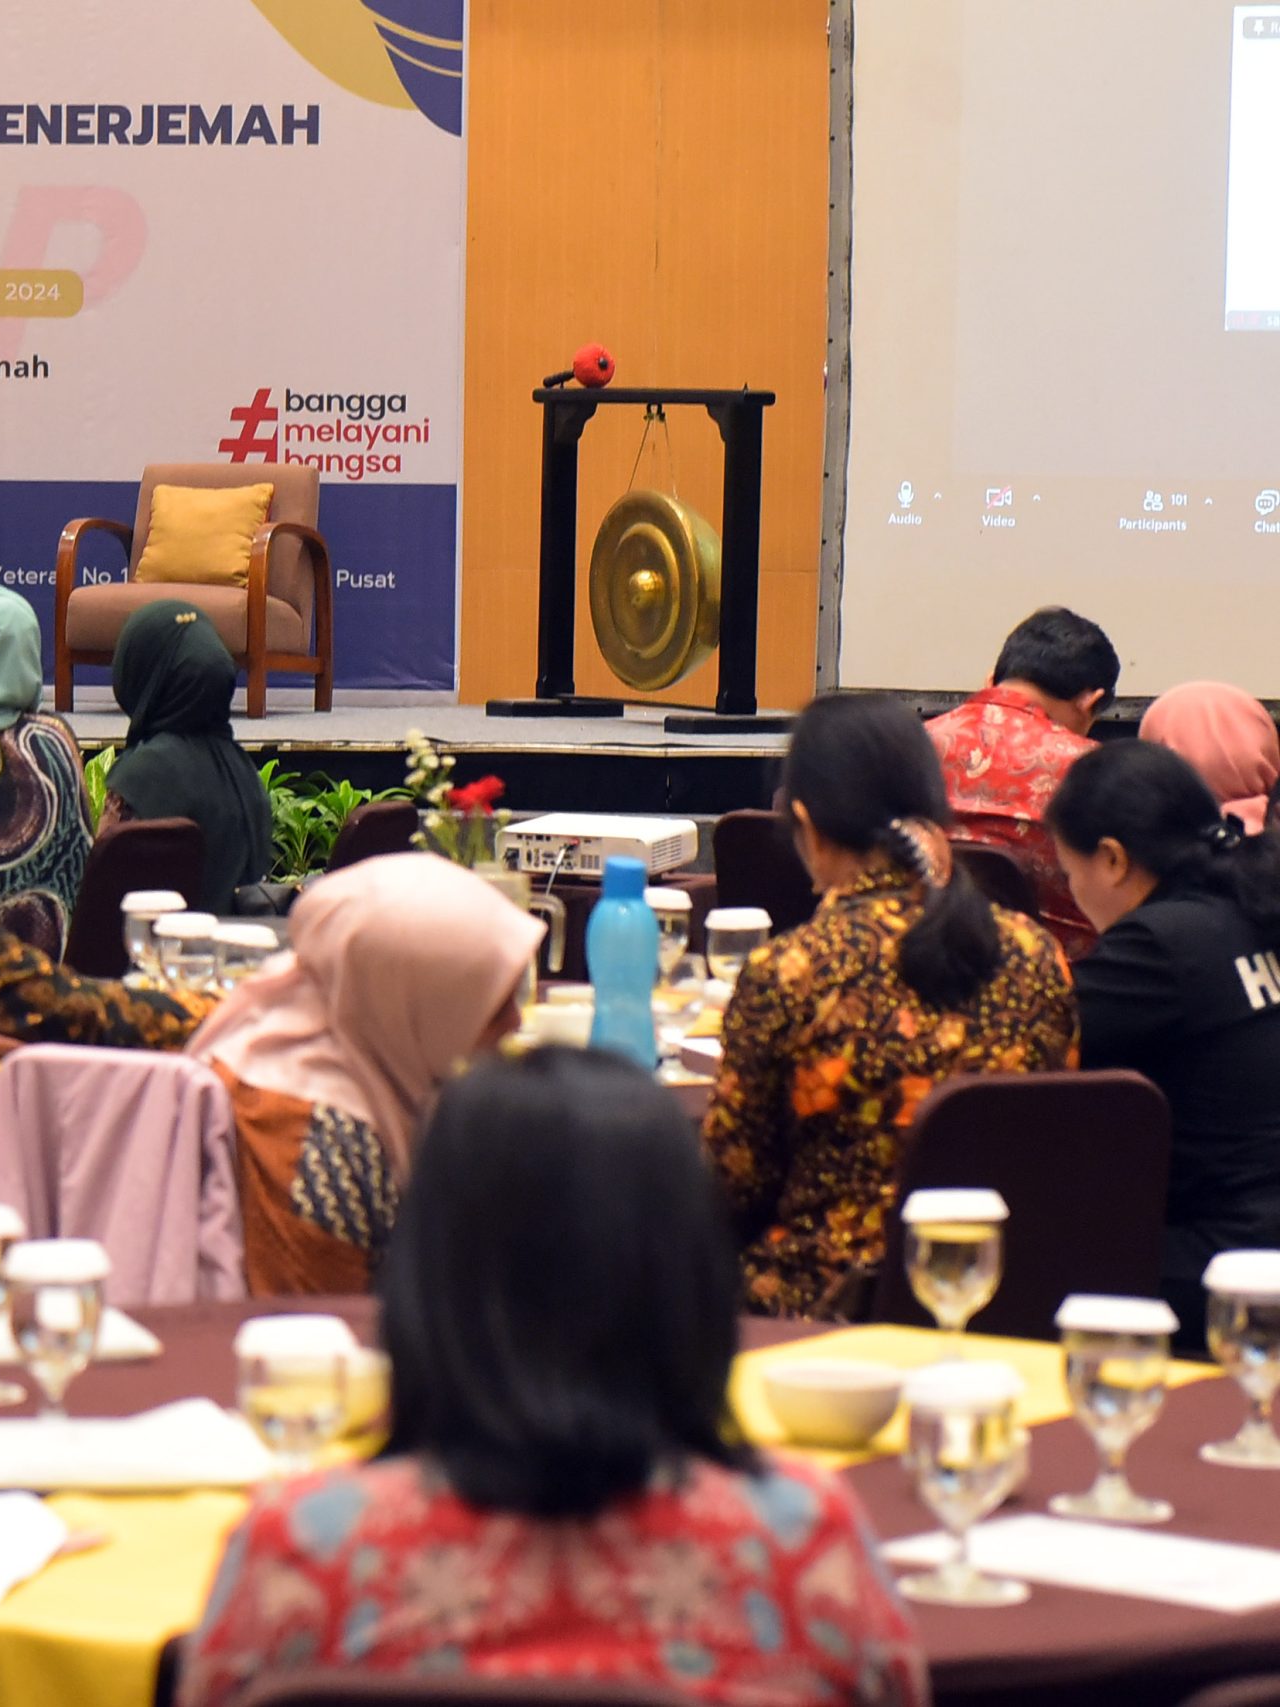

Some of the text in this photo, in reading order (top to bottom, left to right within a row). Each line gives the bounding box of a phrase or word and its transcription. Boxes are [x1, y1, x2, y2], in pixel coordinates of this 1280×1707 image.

[5, 282, 61, 301] 2024
[285, 388, 407, 421] bangga
[284, 418, 430, 451] melayani
[284, 449, 401, 481] bangsa
[1171, 493, 1188, 506] 101
[887, 512, 922, 526] Audio
[981, 514, 1016, 528] Video
[1119, 517, 1187, 533] Participants
[82, 566, 112, 586] No
[336, 569, 396, 589] Pusat
